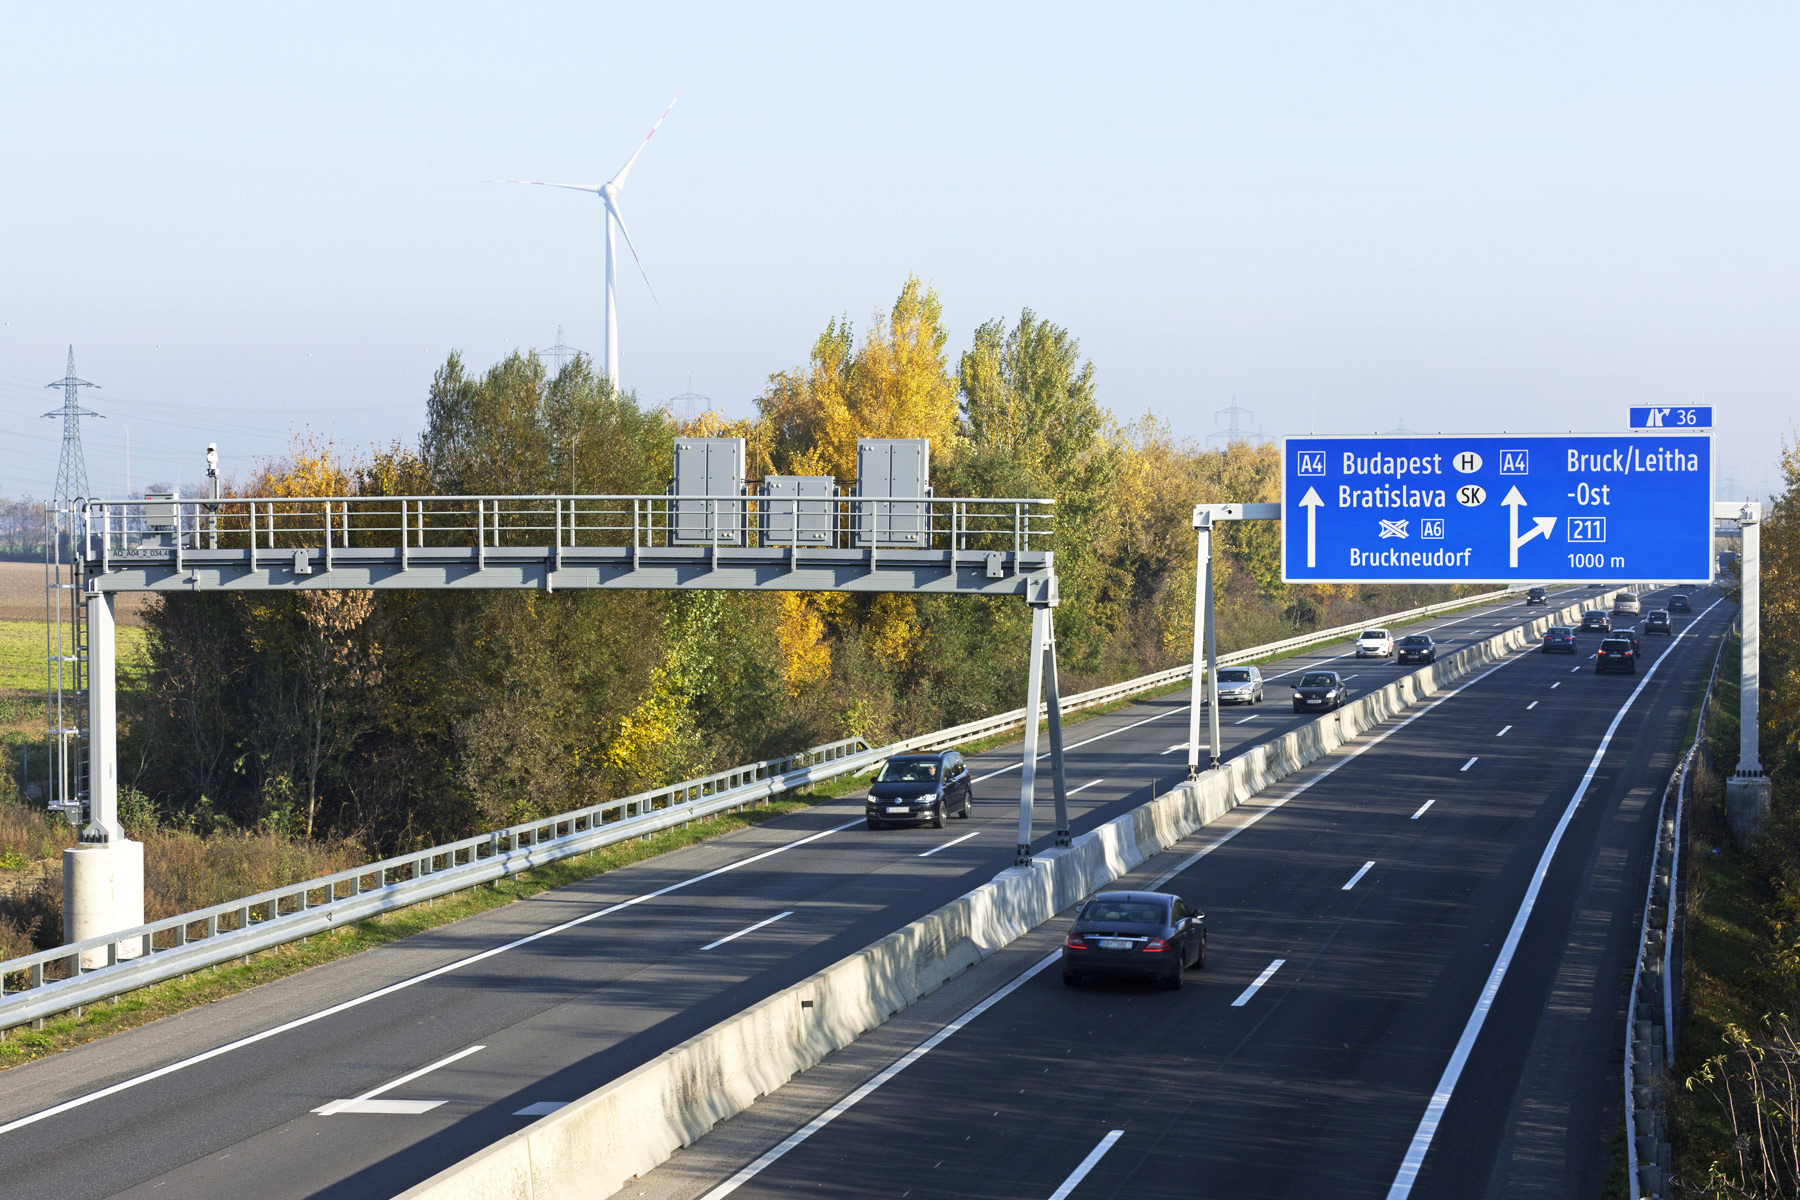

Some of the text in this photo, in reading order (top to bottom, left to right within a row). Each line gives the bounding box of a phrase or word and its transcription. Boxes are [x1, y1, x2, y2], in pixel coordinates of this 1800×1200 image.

[1676, 410, 1697, 425] 36
[1300, 454, 1323, 473] A4
[1343, 452, 1442, 479] Budapest
[1461, 454, 1474, 471] H
[1503, 453, 1526, 472] A4
[1567, 446, 1699, 475] Bruck/Leitha
[1338, 484, 1446, 508] Bratislava
[1461, 487, 1481, 504] SK
[1567, 482, 1611, 506] -Ost
[1423, 521, 1442, 537] A6
[1573, 520, 1602, 539] 211
[1350, 548, 1472, 567] Bruckneudorf
[1567, 553, 1625, 569] 1000 m
